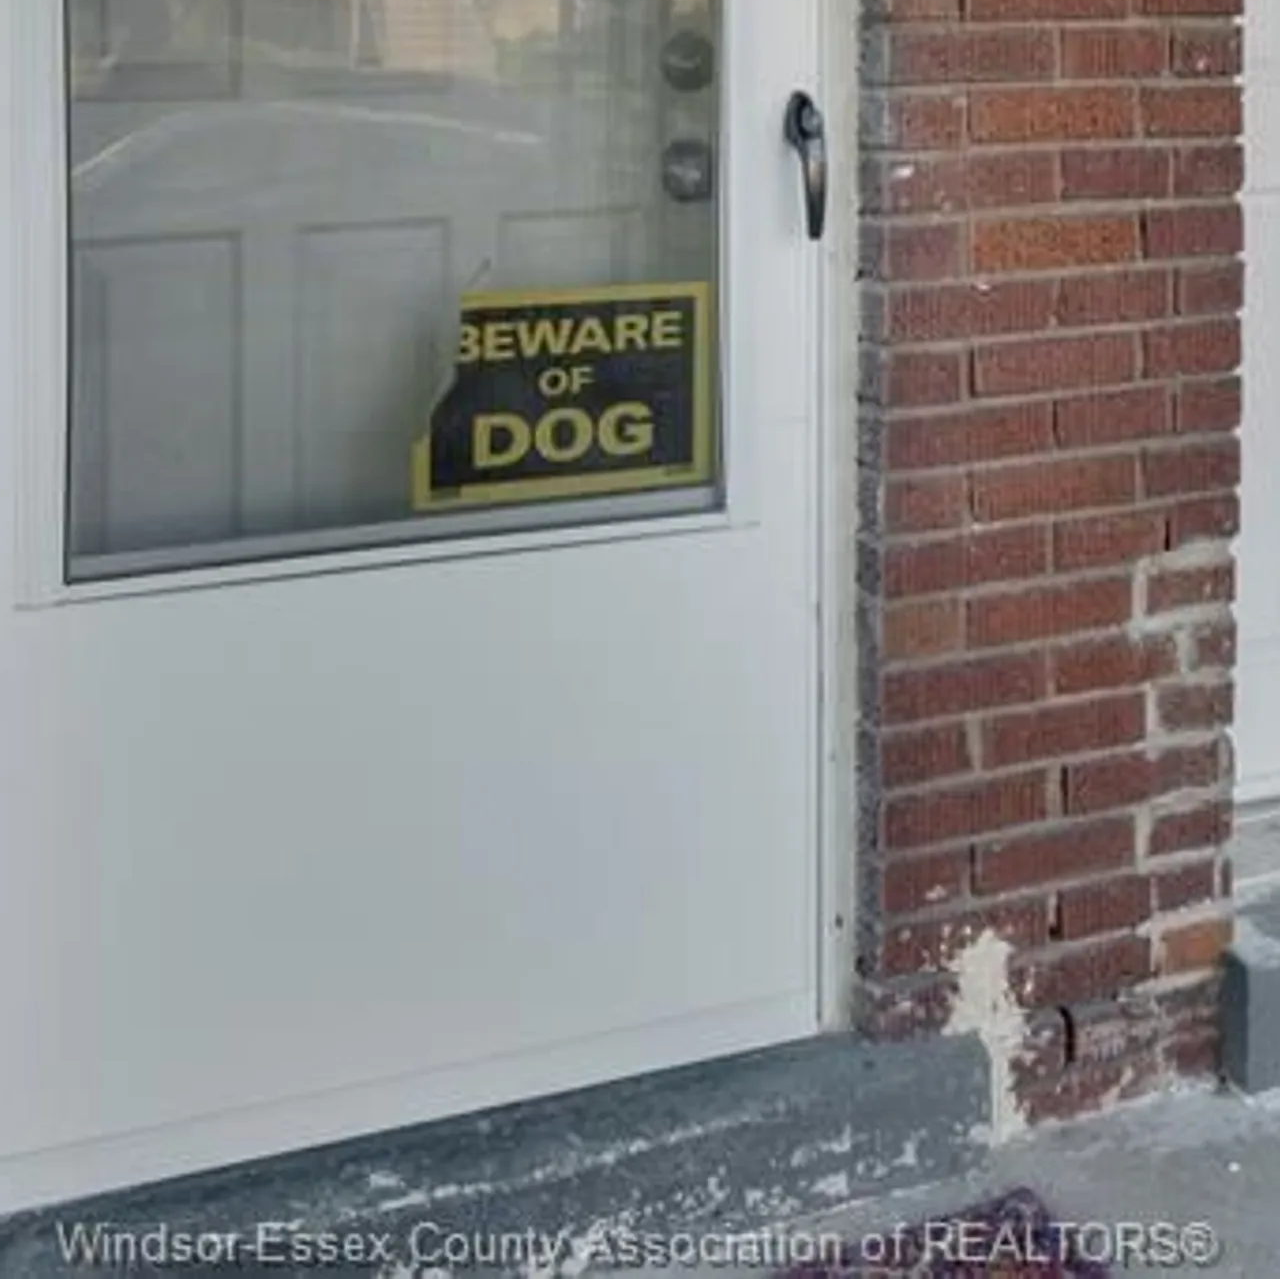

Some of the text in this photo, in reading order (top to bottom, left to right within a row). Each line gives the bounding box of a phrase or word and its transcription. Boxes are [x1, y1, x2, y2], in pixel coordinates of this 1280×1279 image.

[458, 310, 684, 363] BEWARE
[537, 366, 596, 397] OF
[472, 401, 656, 471] DOG
